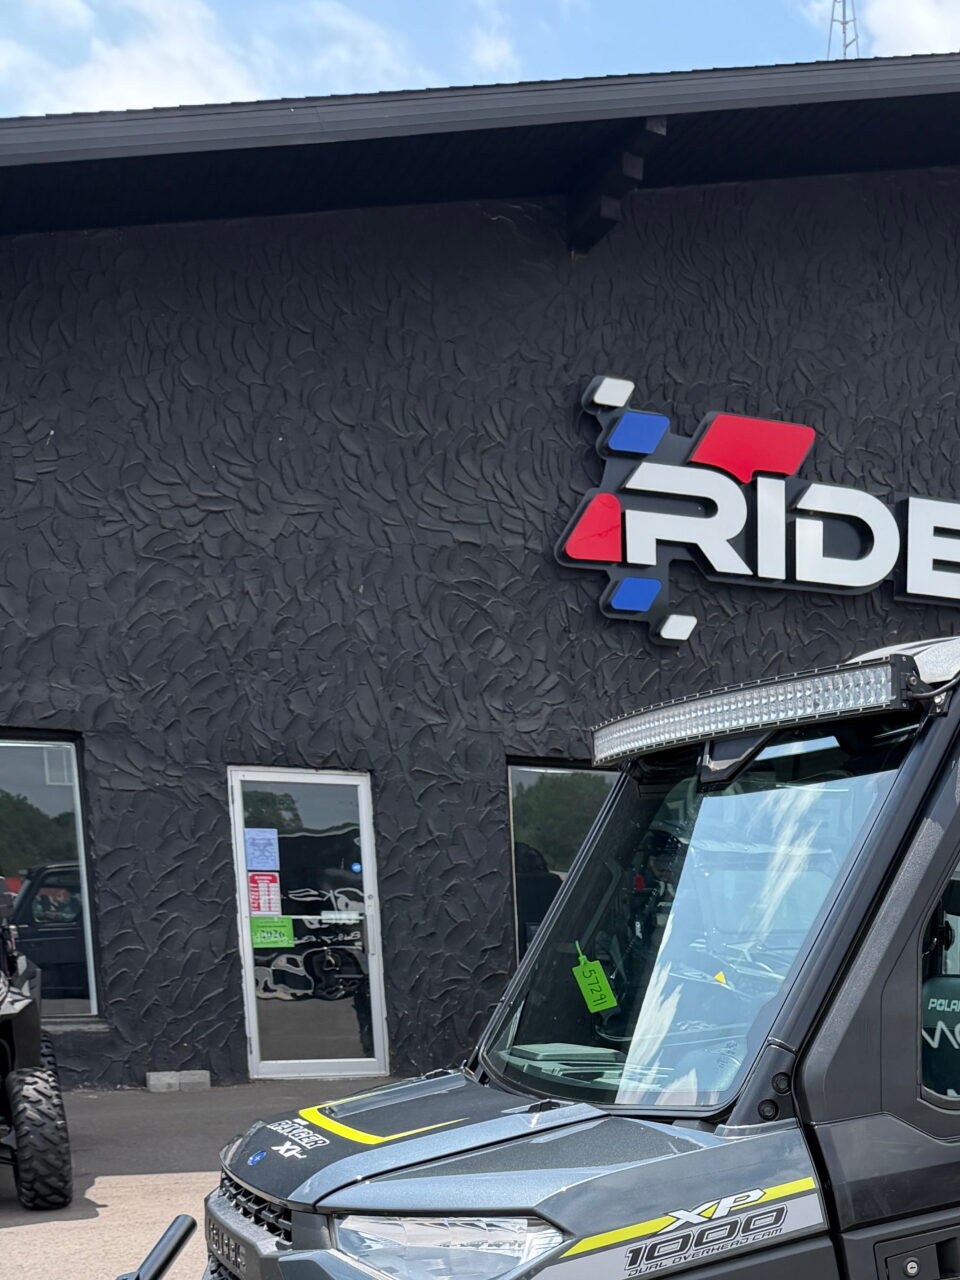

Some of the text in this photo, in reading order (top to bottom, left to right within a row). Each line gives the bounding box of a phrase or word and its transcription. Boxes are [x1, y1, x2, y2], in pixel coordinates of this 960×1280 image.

[582, 969, 608, 1007] 57291
[656, 1188, 766, 1234] XP
[624, 1204, 788, 1271] 1000
[628, 1227, 783, 1277] DUAL OVERHEAD CAM
